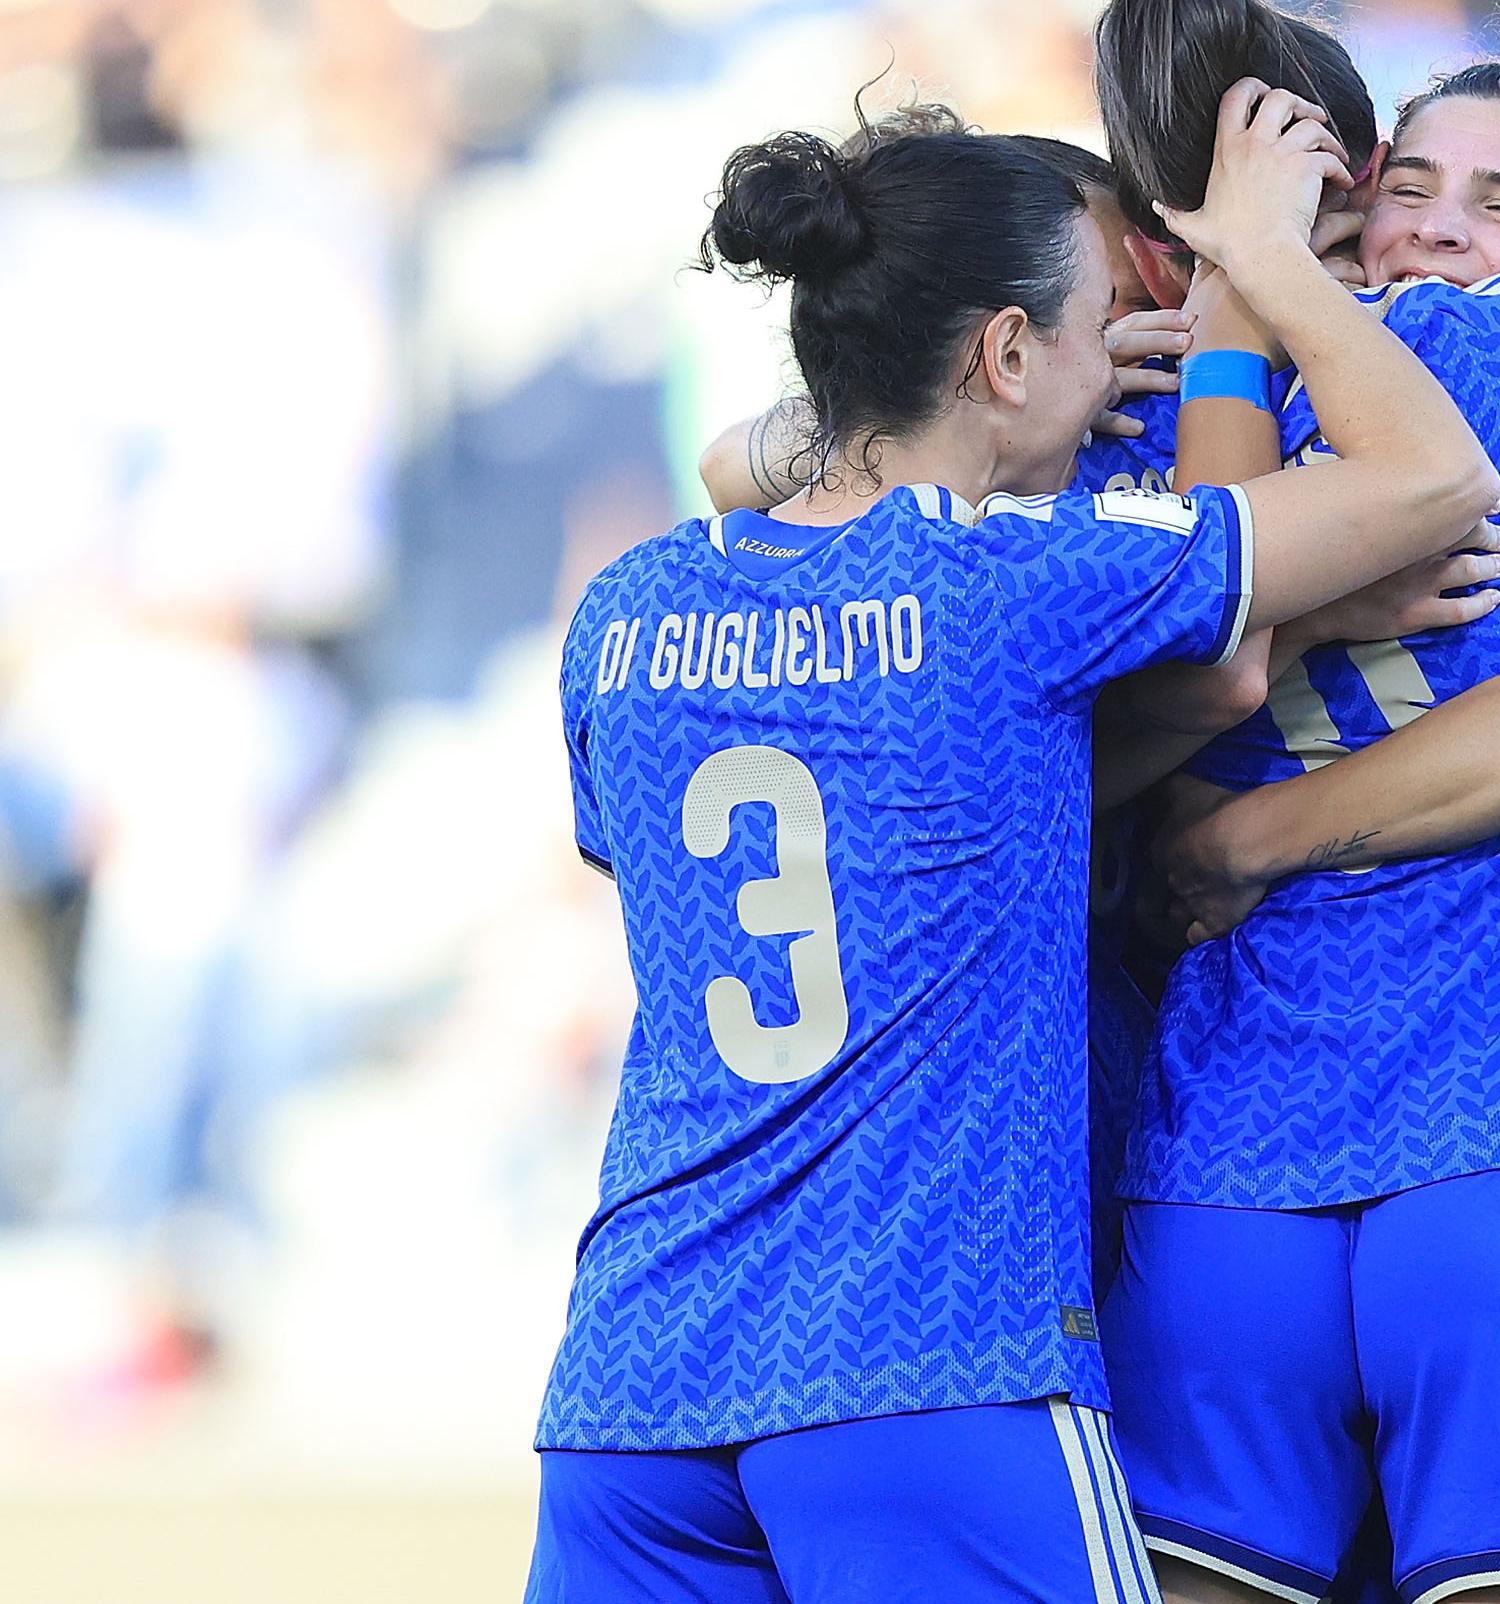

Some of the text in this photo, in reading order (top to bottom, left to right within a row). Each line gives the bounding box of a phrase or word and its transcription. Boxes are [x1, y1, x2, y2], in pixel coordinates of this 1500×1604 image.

[597, 594, 923, 695] DI GUGLIELMO
[682, 744, 850, 1084] 3
